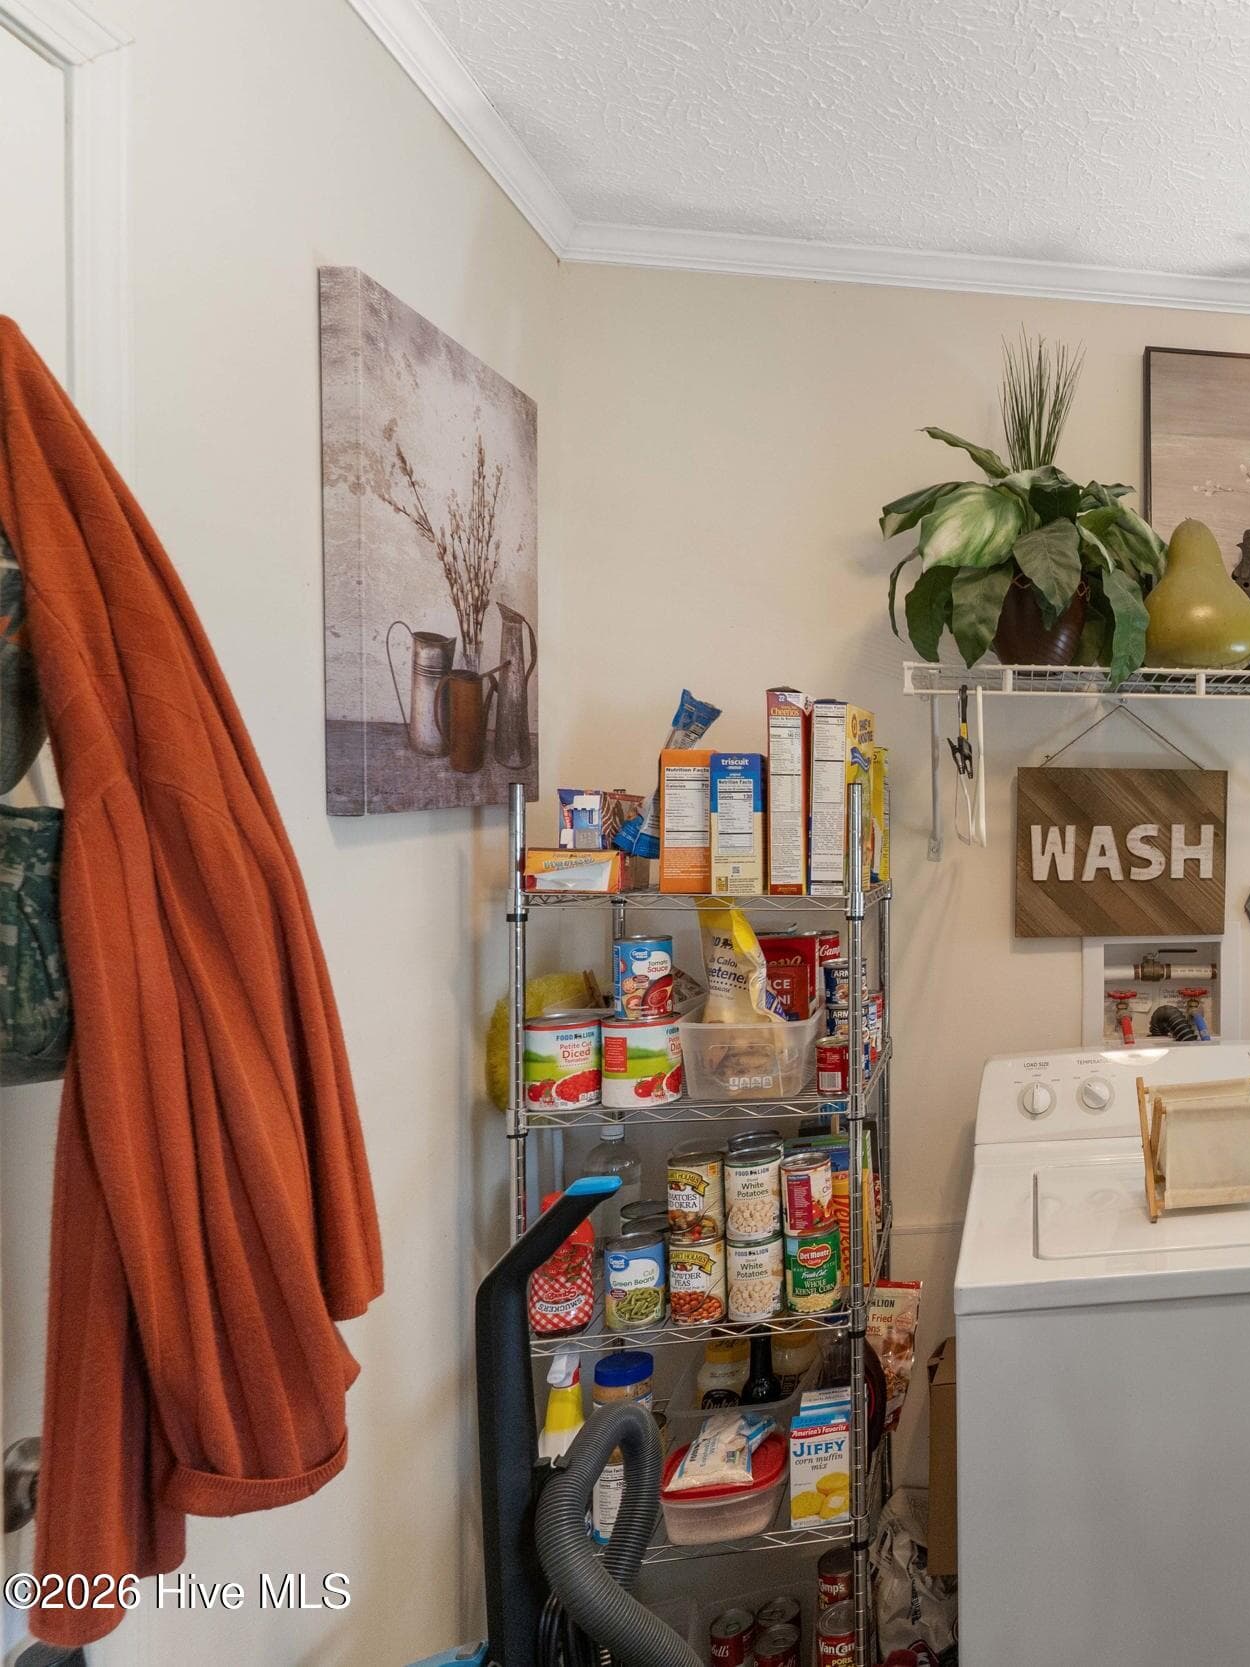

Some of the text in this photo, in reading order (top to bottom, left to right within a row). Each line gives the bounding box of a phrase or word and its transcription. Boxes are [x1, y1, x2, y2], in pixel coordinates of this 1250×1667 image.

[770, 707, 800, 717] Cheerios
[721, 757, 749, 766] triscuit
[1030, 823, 1214, 882] WASH
[582, 1031, 595, 1040] LION
[560, 1040, 592, 1050] Petite Cut
[562, 1048, 591, 1059] Diced
[757, 1167, 770, 1175] LION
[741, 1182, 764, 1190] White
[737, 1189, 769, 1198] Potatoes
[799, 1249, 830, 1260] Del Monte
[740, 1263, 763, 1271] White
[643, 1269, 656, 1277] Cut
[671, 1271, 702, 1280] ROWDER
[736, 1269, 769, 1279] Potatoes
[634, 1275, 656, 1286] Beans
[804, 1279, 827, 1288] WHOLE
[795, 1283, 835, 1296] KERNEL CORN
[877, 1299, 896, 1308] LION
[871, 1313, 893, 1323] Fried
[791, 1424, 847, 1438] America's Favorite
[792, 1440, 845, 1457] JIFFY
[795, 1452, 843, 1466] corn muffin
[811, 1462, 828, 1471] mix
[818, 1640, 834, 1654] Van
[832, 1657, 853, 1666] PORK
